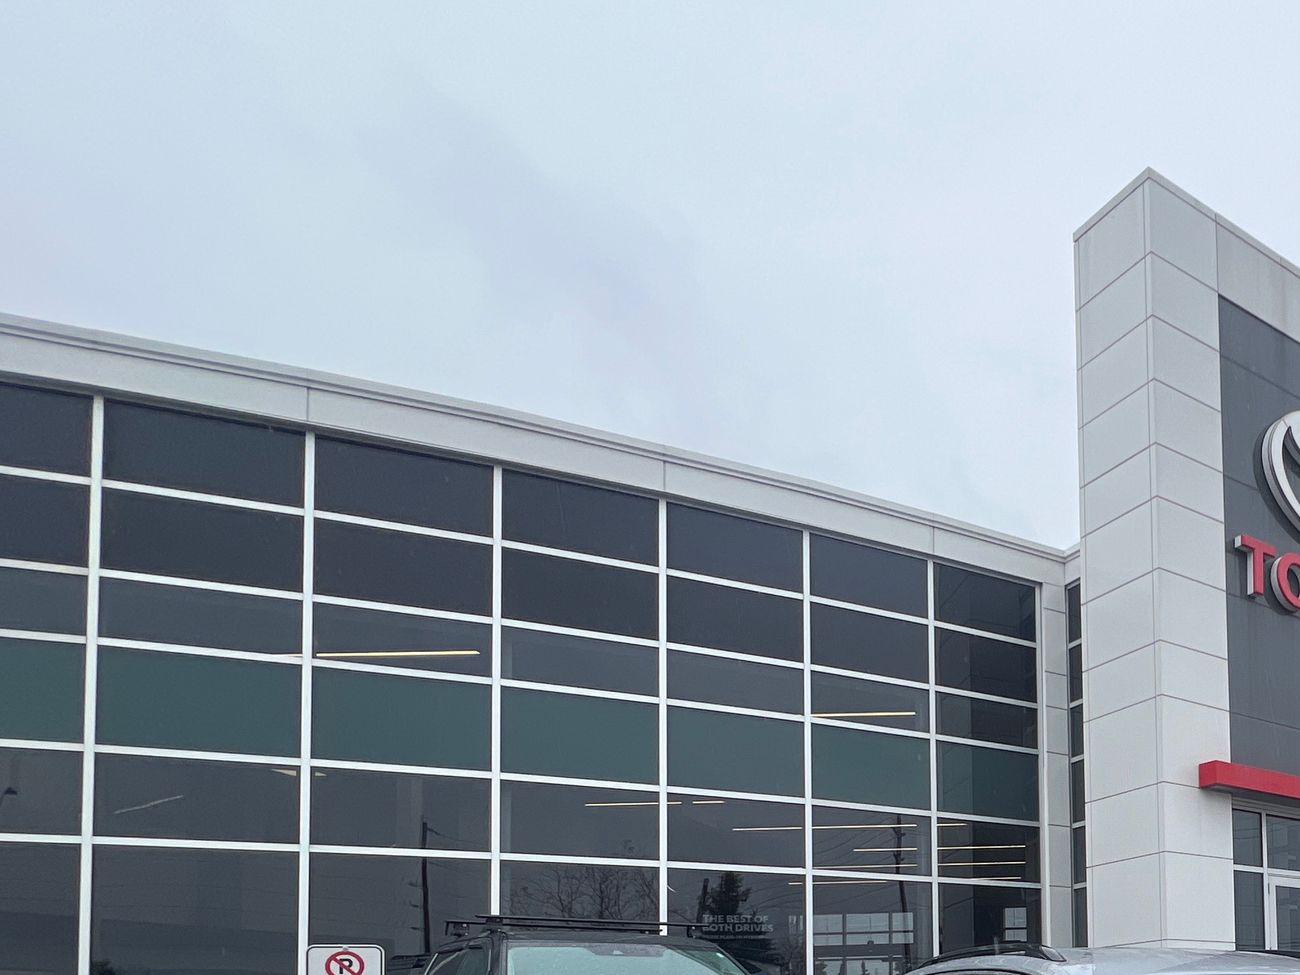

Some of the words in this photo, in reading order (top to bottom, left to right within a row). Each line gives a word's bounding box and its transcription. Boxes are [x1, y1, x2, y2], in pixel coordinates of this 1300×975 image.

[703, 914, 724, 923] THE
[726, 914, 752, 923] BEST
[754, 915, 769, 923] OF
[735, 924, 774, 932] DRIVES
